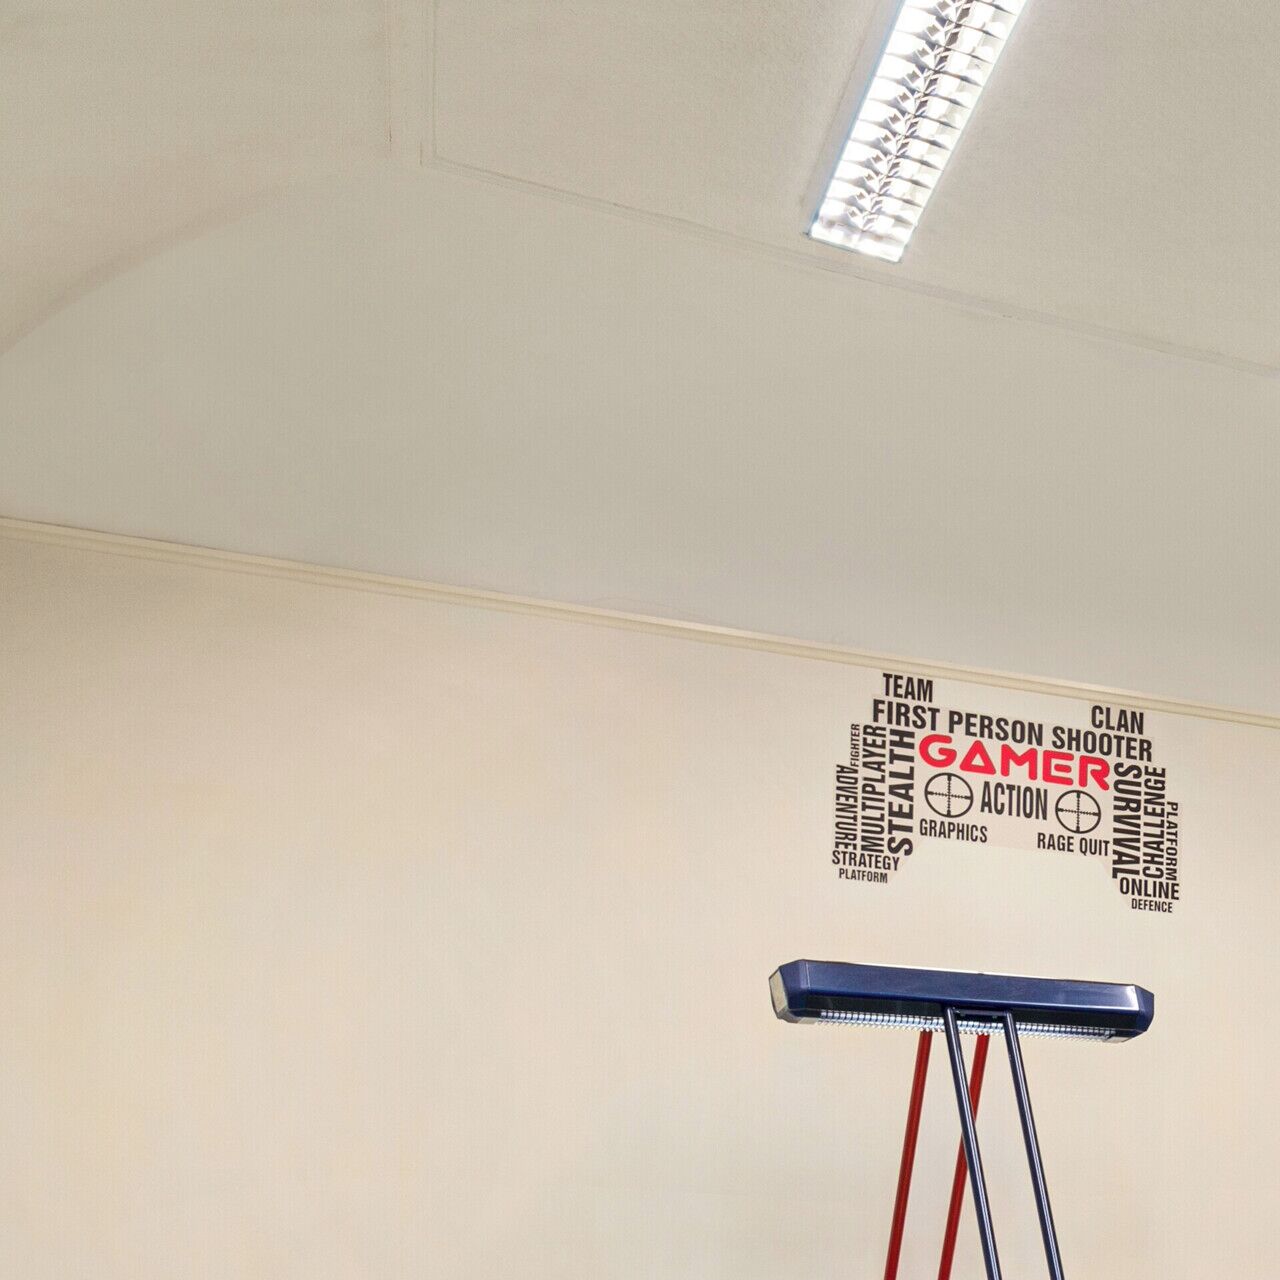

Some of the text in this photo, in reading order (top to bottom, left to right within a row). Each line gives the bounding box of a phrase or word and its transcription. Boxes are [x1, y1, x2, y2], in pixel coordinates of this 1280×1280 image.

[883, 673, 933, 703] TEAM
[873, 699, 1153, 763] FIRST PERSON SHOOTER
[1091, 705, 1144, 735] CLAN
[850, 723, 861, 767] FIGHTER
[919, 734, 1110, 791] GAMER
[834, 764, 858, 851] ADVENTURE
[861, 724, 887, 855] MULTIPLAYER
[887, 728, 916, 856] STEALTH
[980, 781, 1048, 820] ACTION
[919, 818, 988, 843] GRAPHICS
[1111, 762, 1143, 879] SURVIVAL
[1142, 765, 1166, 879] CHALLENGE
[1165, 800, 1178, 881] PLATFORM
[832, 850, 900, 872] STRATEGY
[1037, 832, 1110, 857] RAGE QUIT
[838, 868, 888, 884] PLATFORM
[1119, 877, 1180, 901] ONLINE
[1130, 898, 1173, 914] DEFENCE
